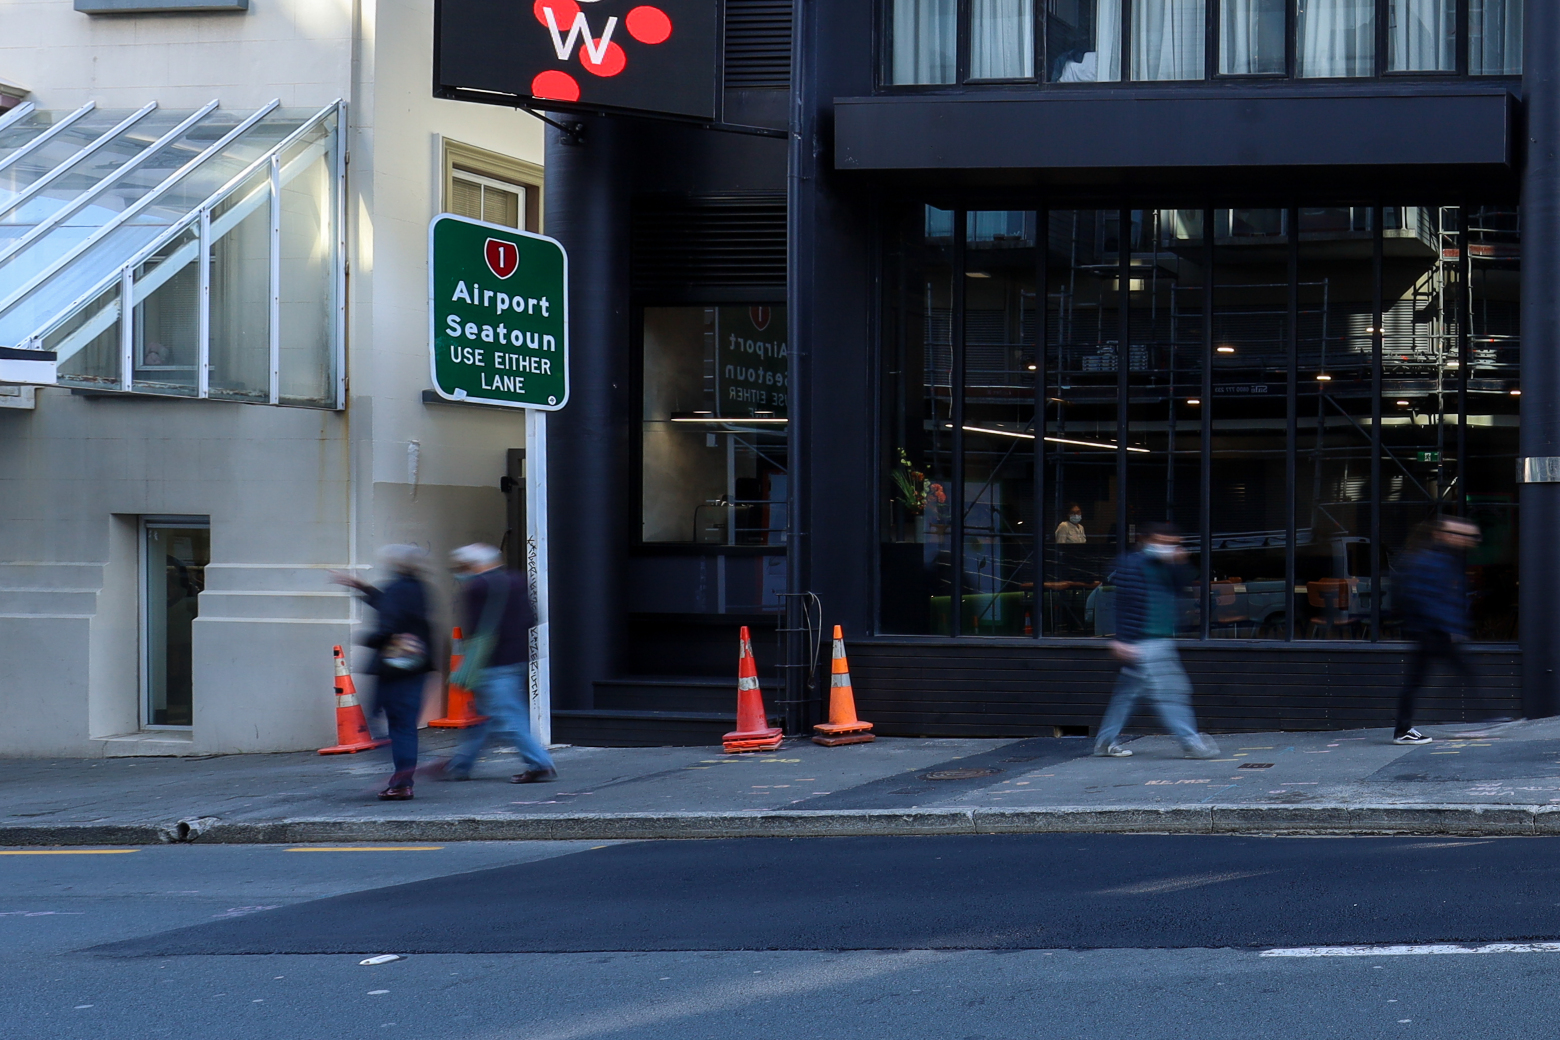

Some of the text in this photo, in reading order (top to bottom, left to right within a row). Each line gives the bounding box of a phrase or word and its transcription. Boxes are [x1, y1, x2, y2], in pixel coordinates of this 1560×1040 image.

[498, 246, 505, 268] 1
[451, 280, 550, 318] Airport
[445, 314, 556, 352] Seatoun
[450, 345, 552, 375] USE EITHER
[481, 372, 526, 394] LANE
